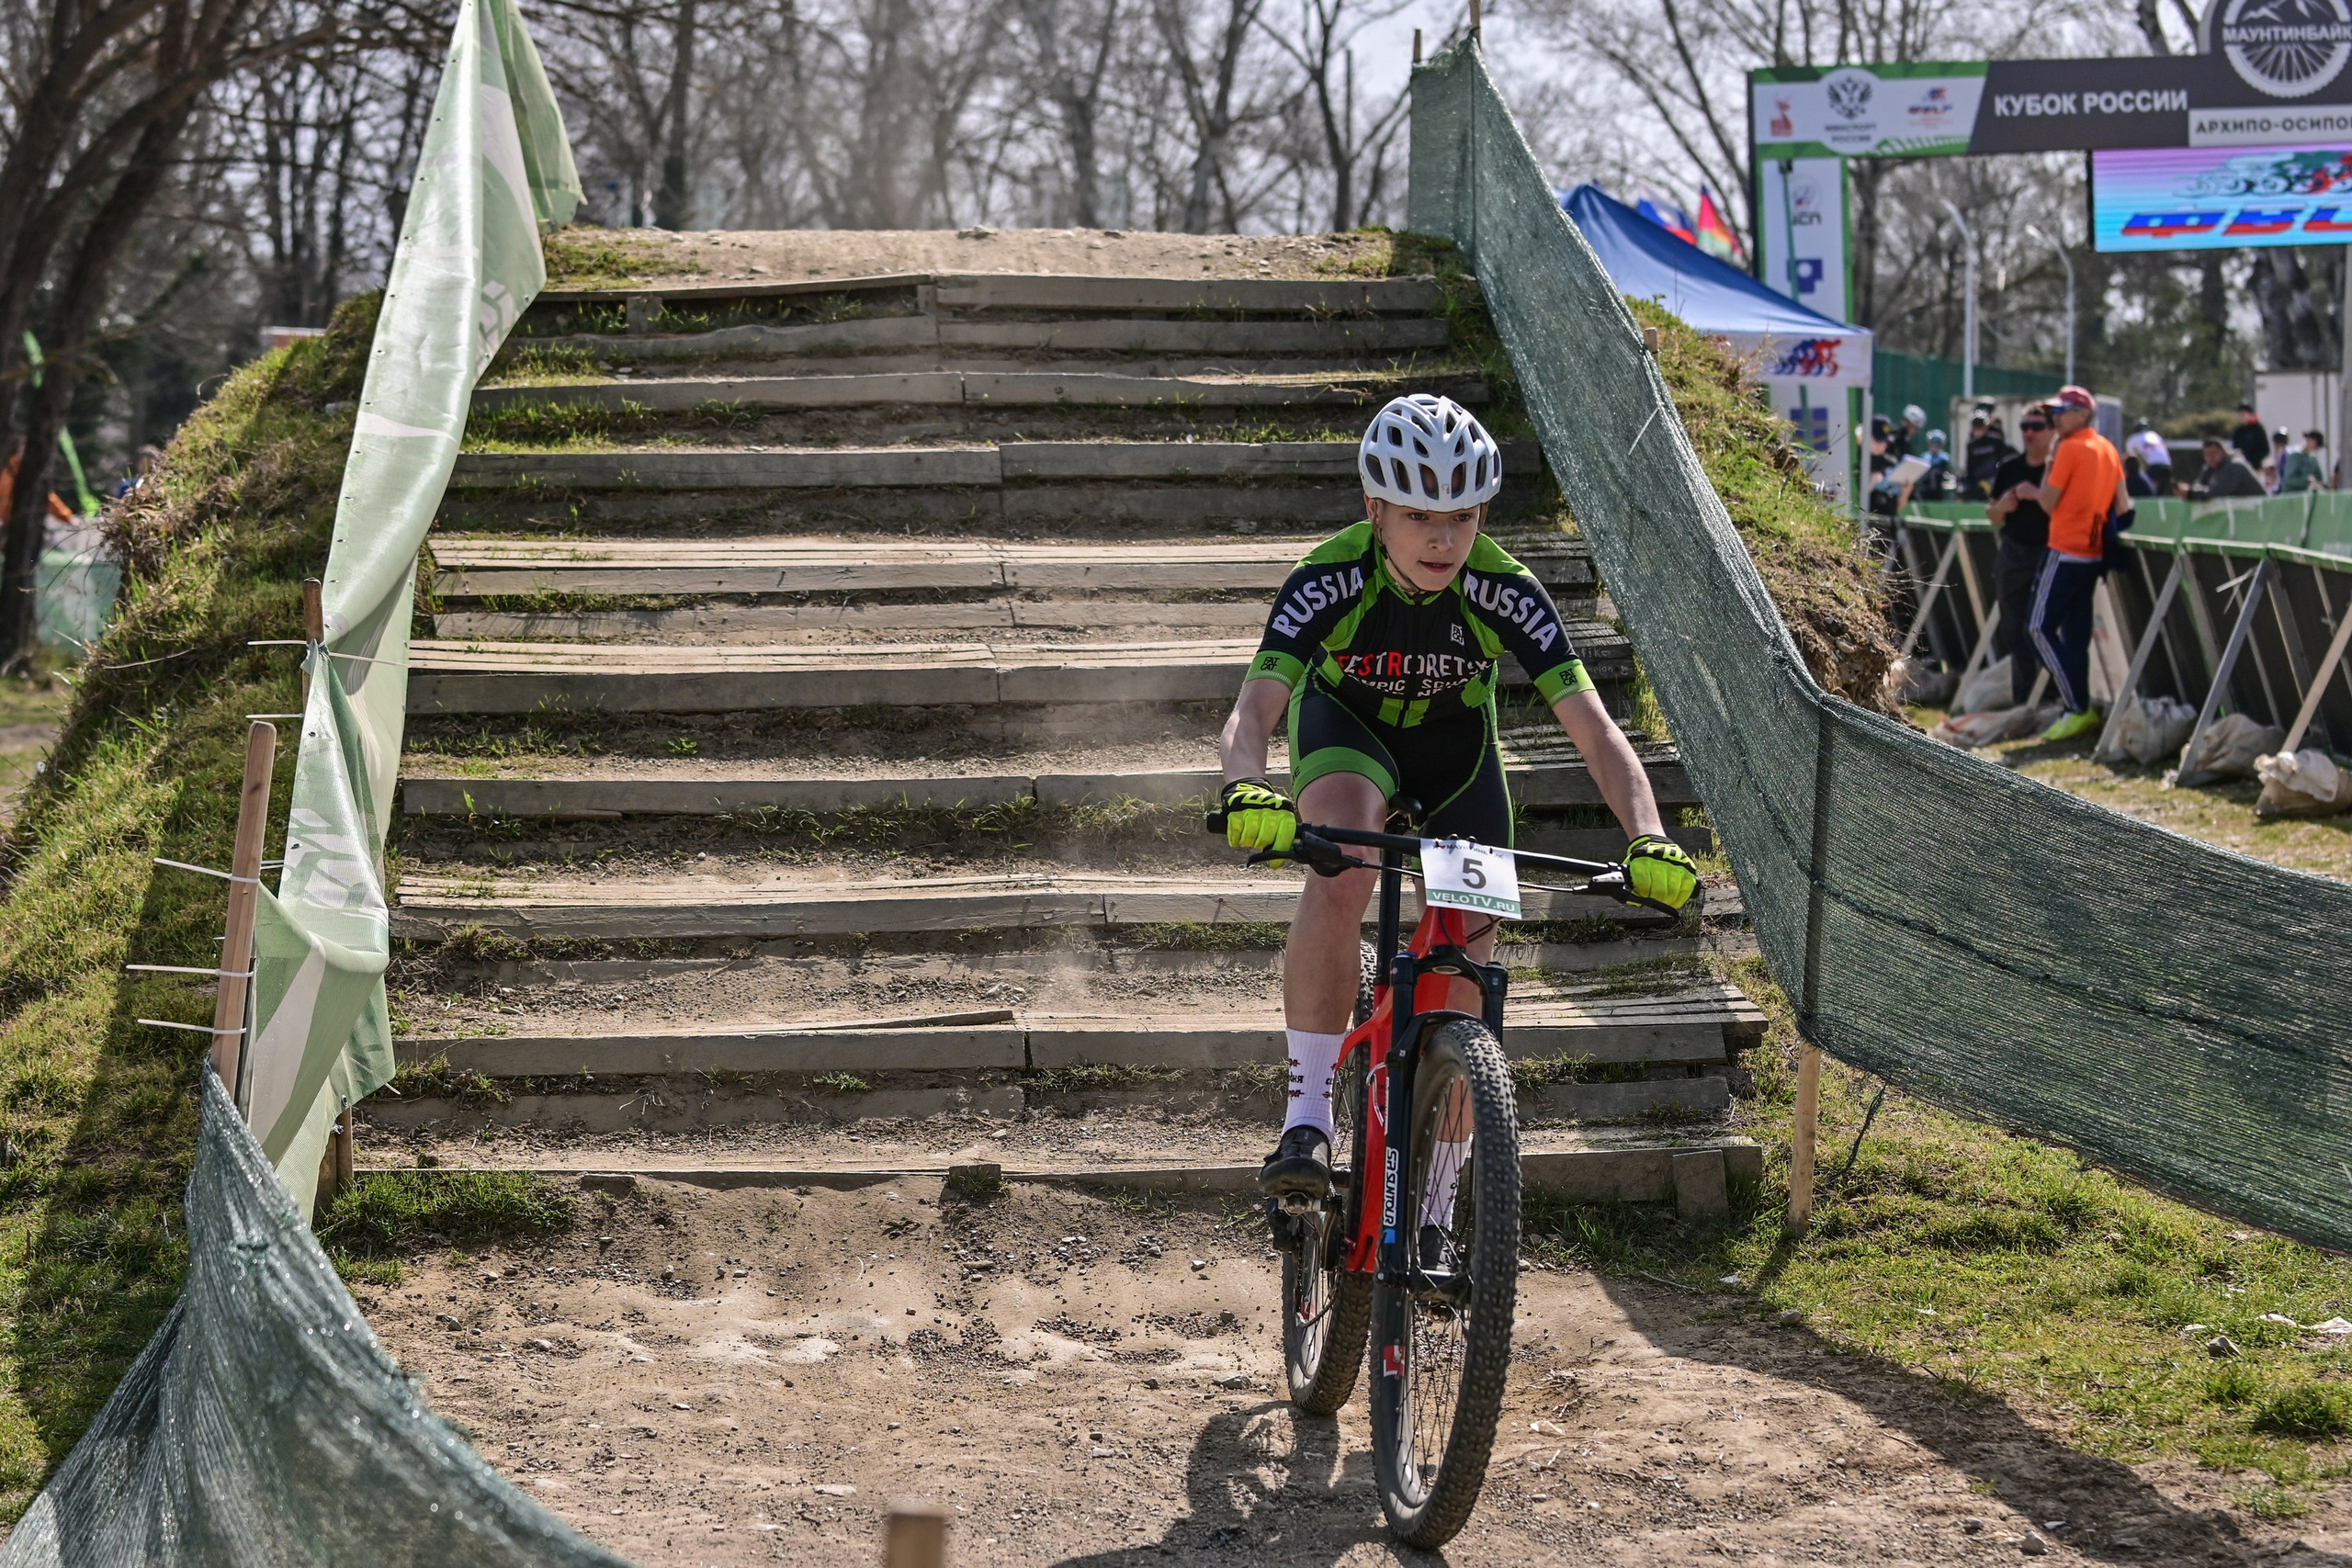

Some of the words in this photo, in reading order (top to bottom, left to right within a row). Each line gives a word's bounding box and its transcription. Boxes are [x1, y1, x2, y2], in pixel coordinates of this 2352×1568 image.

[1994, 93, 2076, 117] КУБОК
[2082, 89, 2188, 114] РОССИИ
[2195, 116, 2352, 134] АРХИПО-ОСИПО
[1272, 566, 1364, 639] RUSSIA
[1463, 570, 1558, 652] RUSSIA
[1261, 662, 1278, 671] CAT
[1263, 656, 1281, 664] FAT
[1559, 668, 1574, 680] FAT
[1563, 674, 1577, 686] CAT
[1462, 857, 1487, 889] 5
[1384, 1172, 1396, 1225] SUNTOUR
